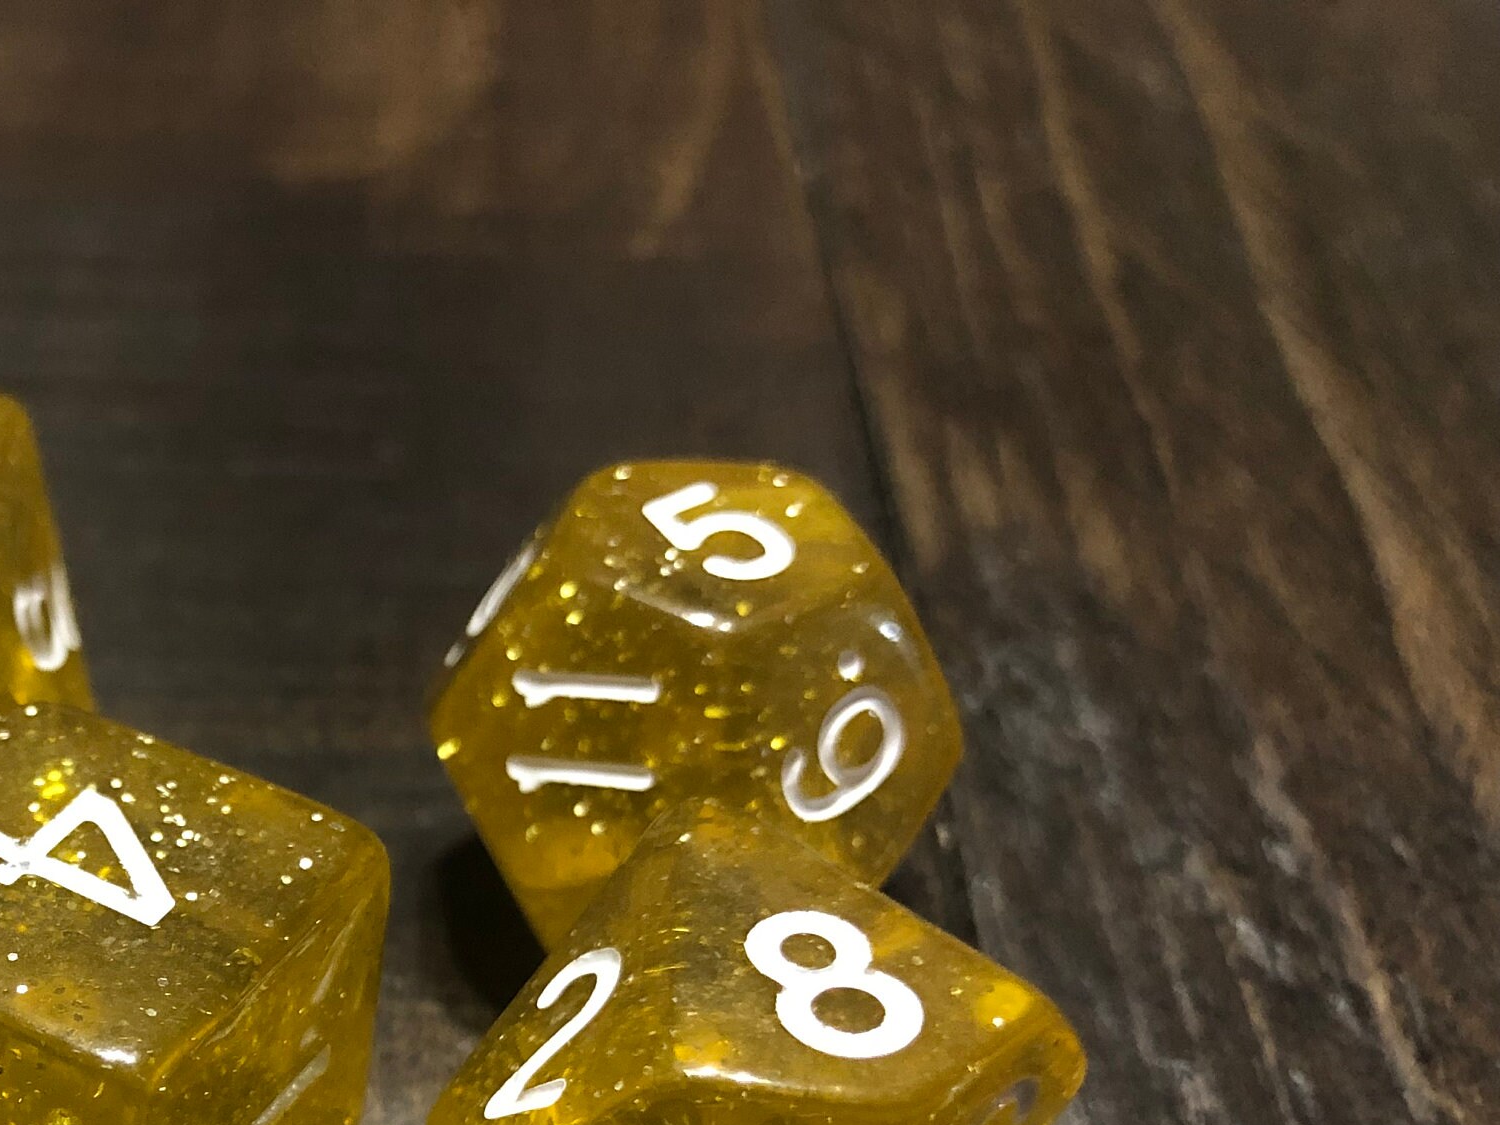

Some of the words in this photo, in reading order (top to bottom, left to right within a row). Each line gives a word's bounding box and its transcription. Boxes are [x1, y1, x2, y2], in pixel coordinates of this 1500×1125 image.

[641, 481, 797, 581] 5
[504, 667, 661, 793] 11
[483, 947, 623, 1120] 2
[743, 909, 925, 1059] 8
